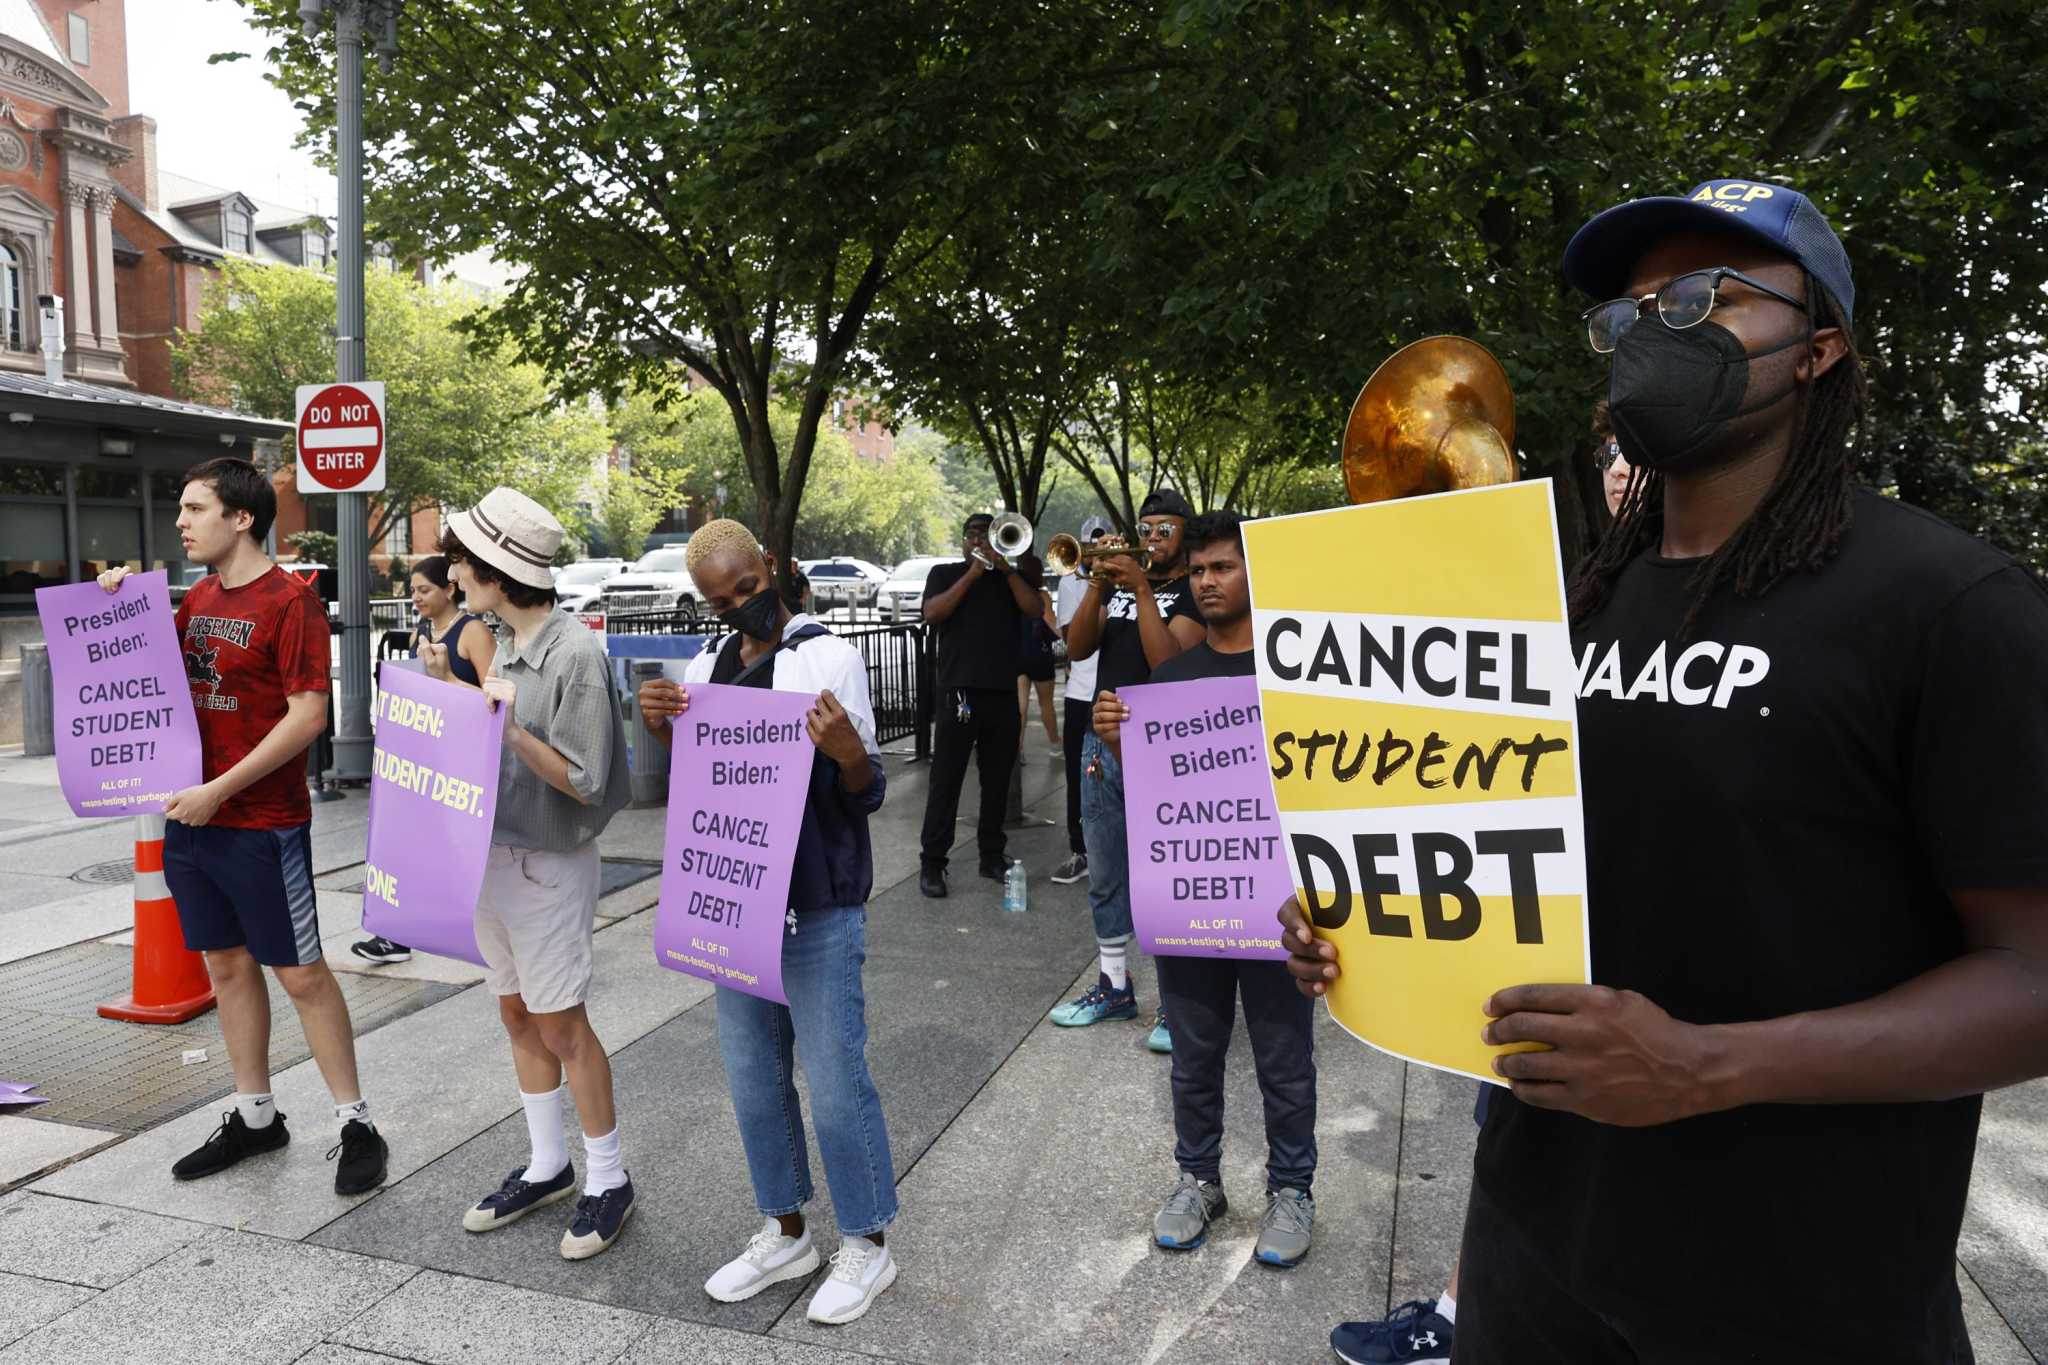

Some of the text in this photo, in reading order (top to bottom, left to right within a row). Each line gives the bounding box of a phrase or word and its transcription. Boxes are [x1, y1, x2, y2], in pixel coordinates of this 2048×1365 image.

[310, 404, 371, 424] DO NOT
[316, 452, 364, 470] ENTER
[64, 593, 150, 637] President
[87, 632, 148, 663] Biden:
[1265, 617, 1551, 706] CANCEL
[79, 677, 166, 704] CANCEL
[72, 707, 174, 737] STUDENT
[388, 695, 444, 738] BIDEN:
[1144, 704, 1262, 744] Presiden
[696, 718, 802, 746] President
[91, 741, 155, 767] DEBT!
[1170, 745, 1257, 777] Biden:
[1271, 728, 1568, 792] STUDENT
[101, 777, 142, 791] ALL OF IT!
[373, 747, 484, 818] TUDENT DEBT.
[712, 761, 779, 785] Biden:
[1156, 798, 1271, 825] CANCEL
[692, 810, 769, 848] CANCEL
[1150, 836, 1279, 863] STUDENT
[681, 848, 767, 890] STUDENT
[366, 863, 399, 907] ONE.
[1173, 876, 1254, 900] DEBT!
[1290, 828, 1566, 944] DEBT
[688, 891, 742, 929] DEBT!
[1189, 919, 1244, 929] ALL OF IT!
[691, 937, 729, 958] ALL OF IT!
[1155, 936, 1225, 948] means-testing
[1226, 937, 1236, 947] is
